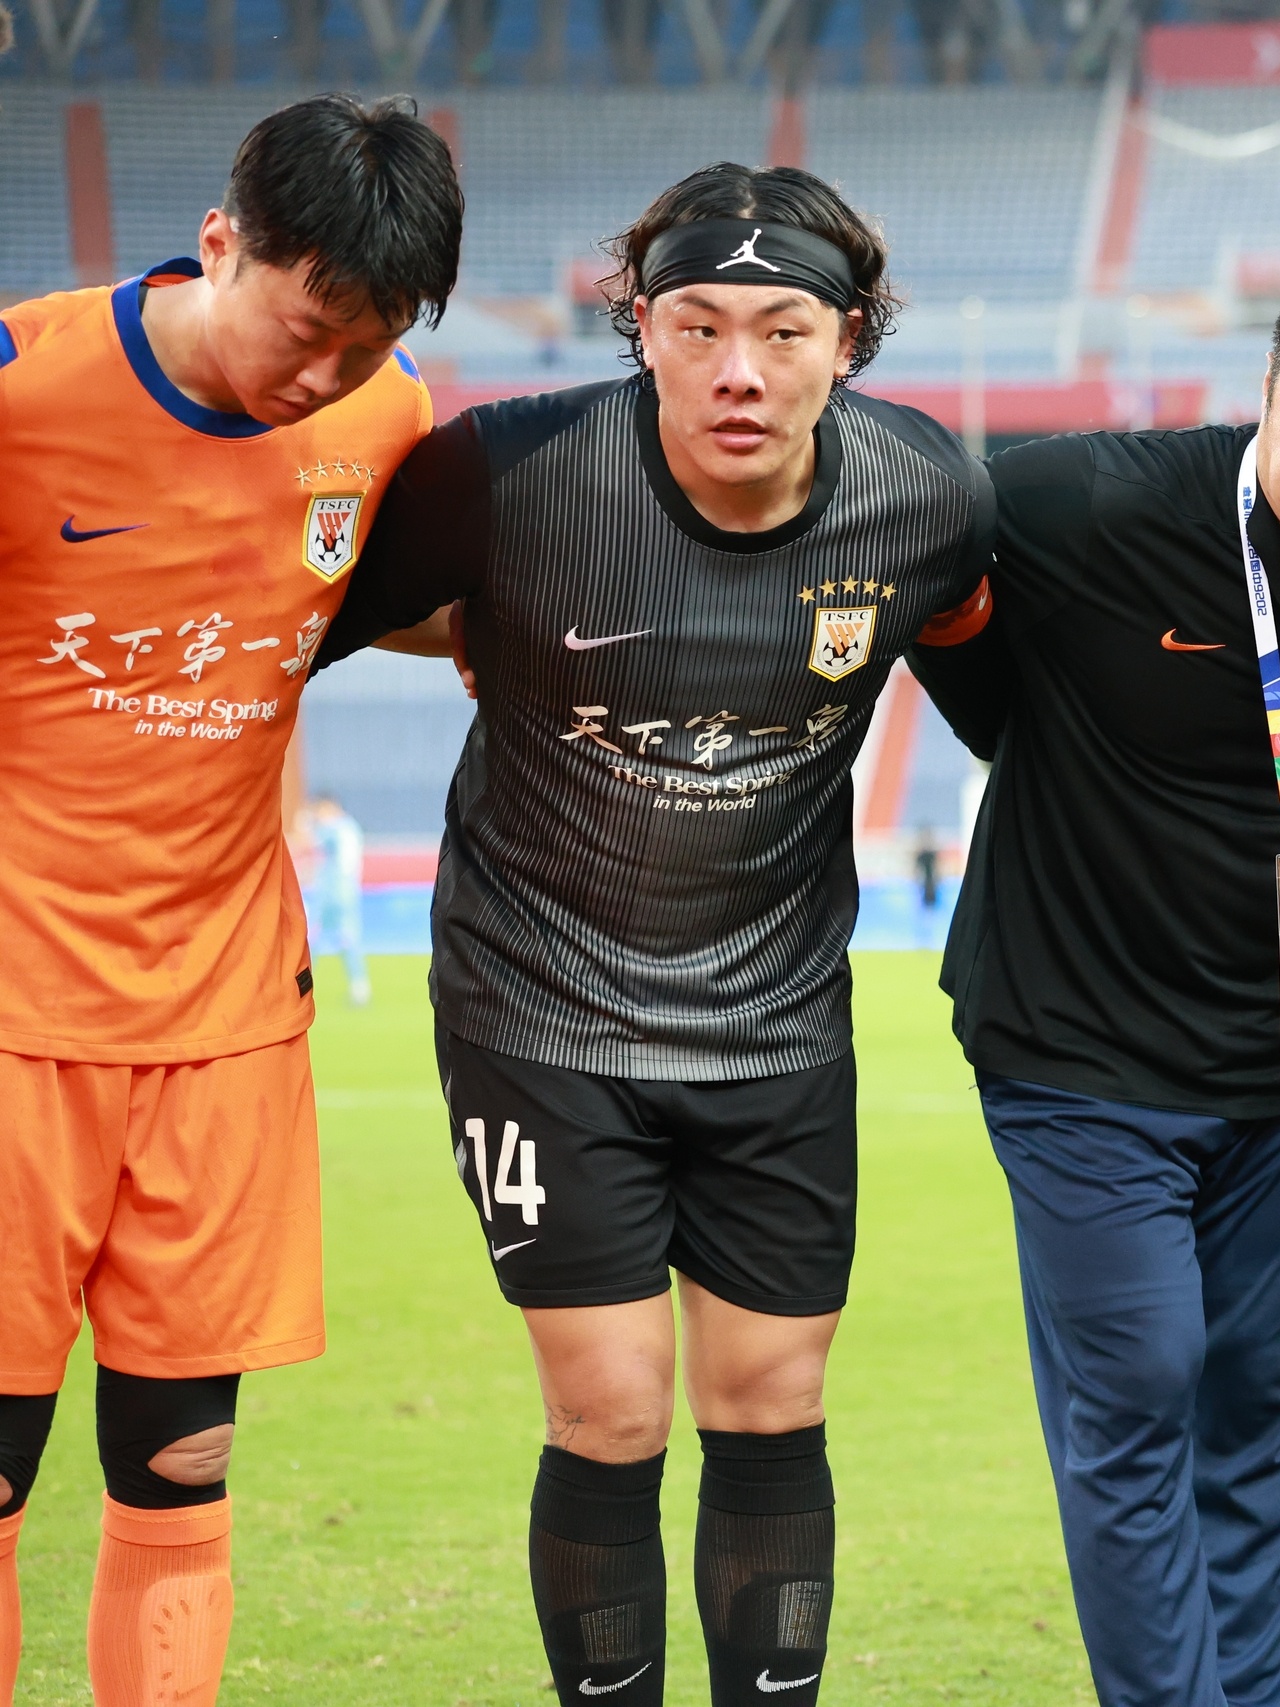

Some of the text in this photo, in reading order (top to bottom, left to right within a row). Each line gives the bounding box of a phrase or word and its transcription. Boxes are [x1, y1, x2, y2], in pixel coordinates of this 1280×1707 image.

[318, 500, 355, 510] TSFC
[824, 611, 868, 621] TSFC
[88, 688, 278, 724] The Best Spring
[135, 719, 243, 740] in the World
[608, 765, 798, 797] The Best Spring
[653, 795, 756, 812] in the World
[465, 1117, 546, 1226] 14
